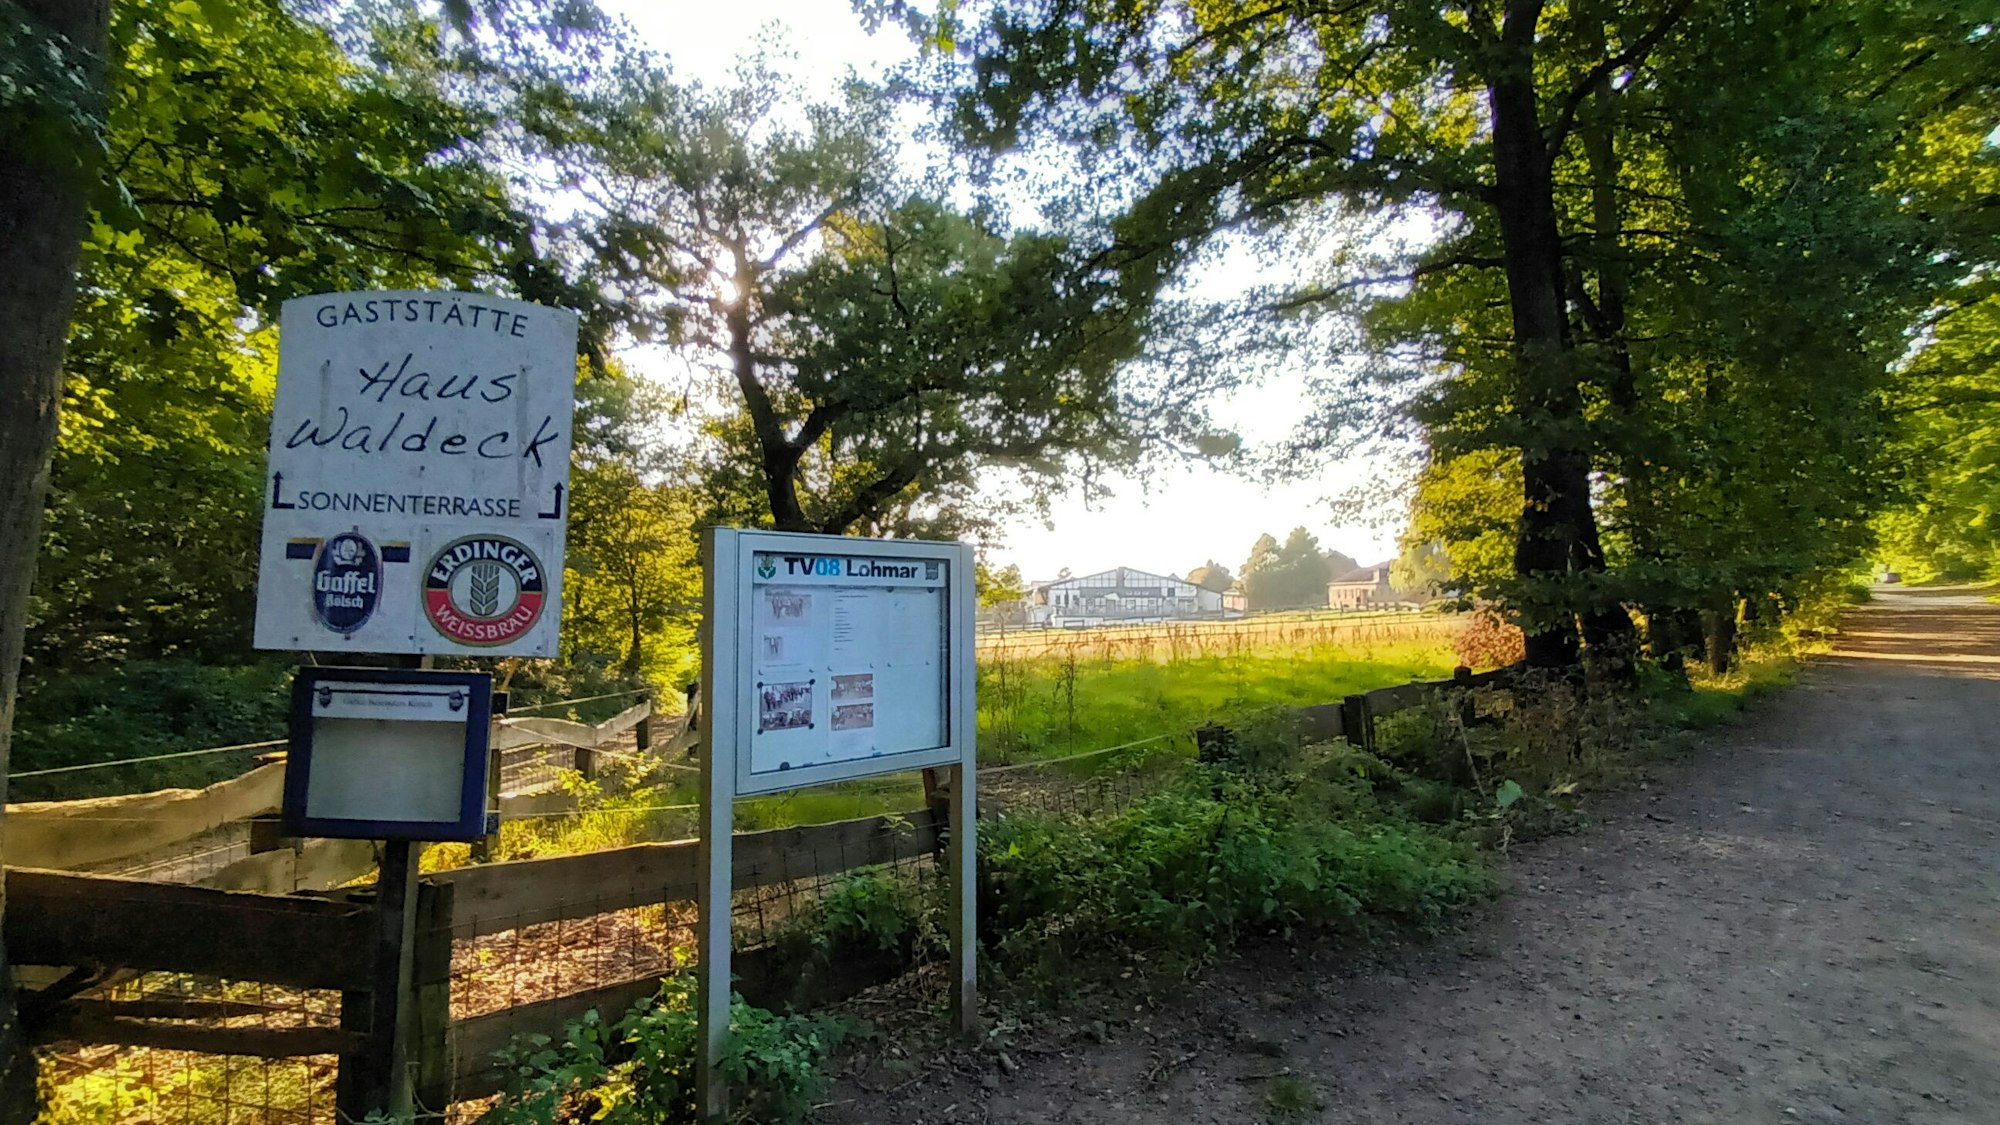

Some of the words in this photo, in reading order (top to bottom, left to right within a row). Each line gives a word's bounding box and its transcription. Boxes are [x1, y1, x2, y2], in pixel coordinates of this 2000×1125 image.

[316, 297, 529, 338] GASTSTÄTTE
[359, 353, 518, 402] Haus
[285, 406, 559, 468] Waldeck
[298, 491, 521, 518] SONNENTERRASSE
[430, 539, 538, 584] ERDINGER
[784, 557, 841, 577] TV08
[846, 559, 918, 579] Lohmar
[316, 570, 376, 594] Gaffel
[435, 604, 534, 640] WEISSBRÄU
